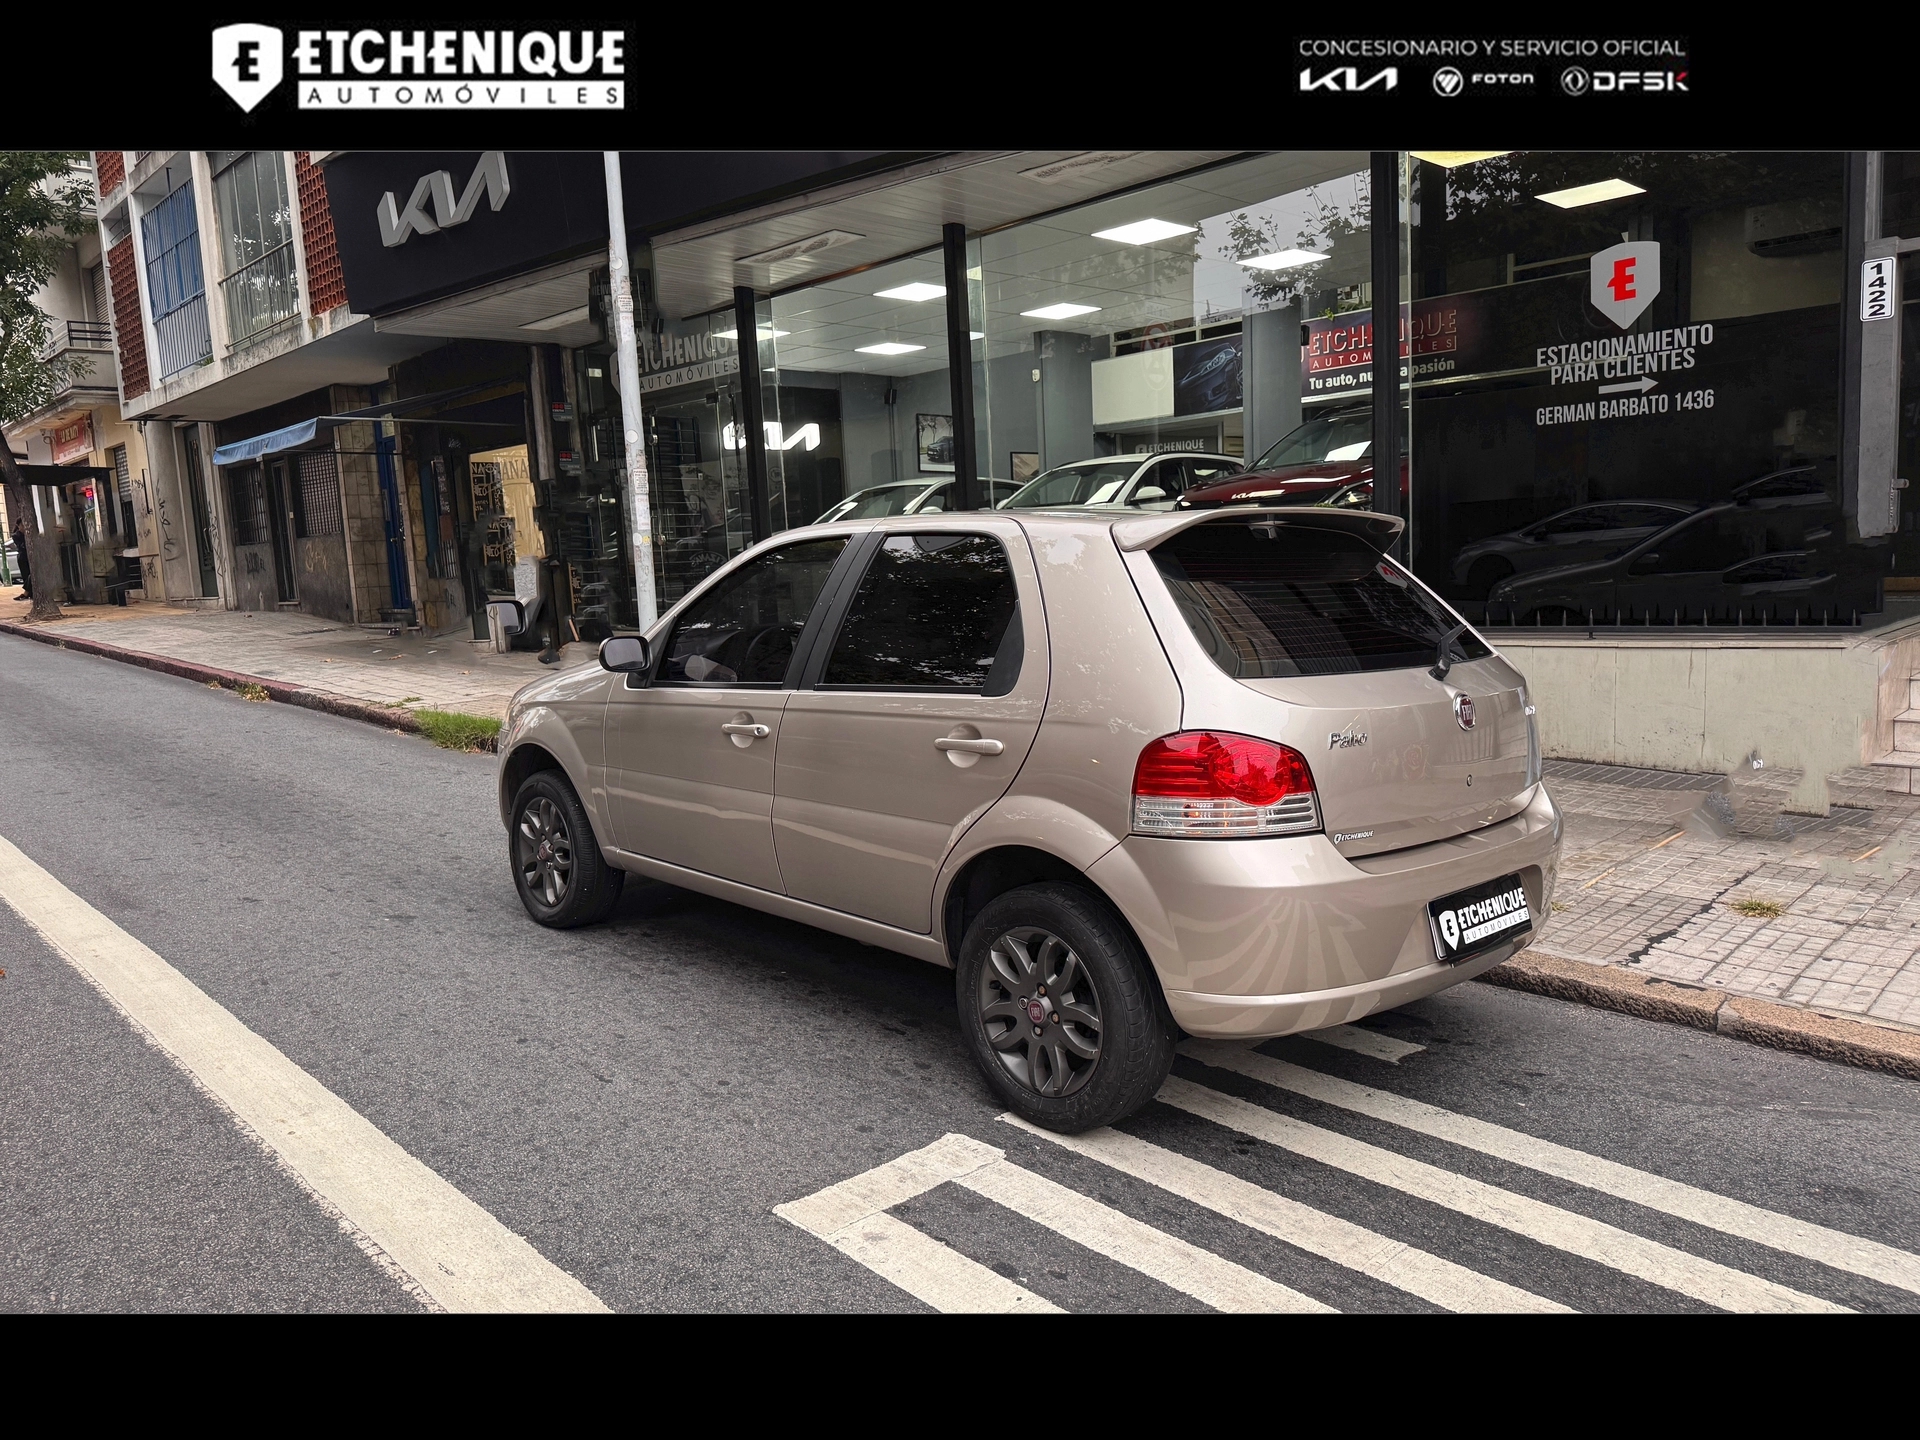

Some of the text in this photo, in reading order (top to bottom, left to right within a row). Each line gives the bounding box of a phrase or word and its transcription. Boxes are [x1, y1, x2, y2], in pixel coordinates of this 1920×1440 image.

[377, 150, 510, 247] KIA
[1868, 263, 1887, 317] 1422
[1536, 323, 1714, 367] ESTACIONAMIENTO
[1309, 377, 1323, 390] Tu
[1325, 373, 1357, 387] auto,
[1411, 358, 1455, 379] pasión
[1551, 348, 1696, 386] PARA CLIENTES
[1536, 389, 1715, 426] GERMAN BARBATO 1436
[1149, 439, 1204, 453] ETCHENIQUE
[1328, 730, 1367, 750] Palio
[1457, 887, 1527, 929] ETCHENIQUE
